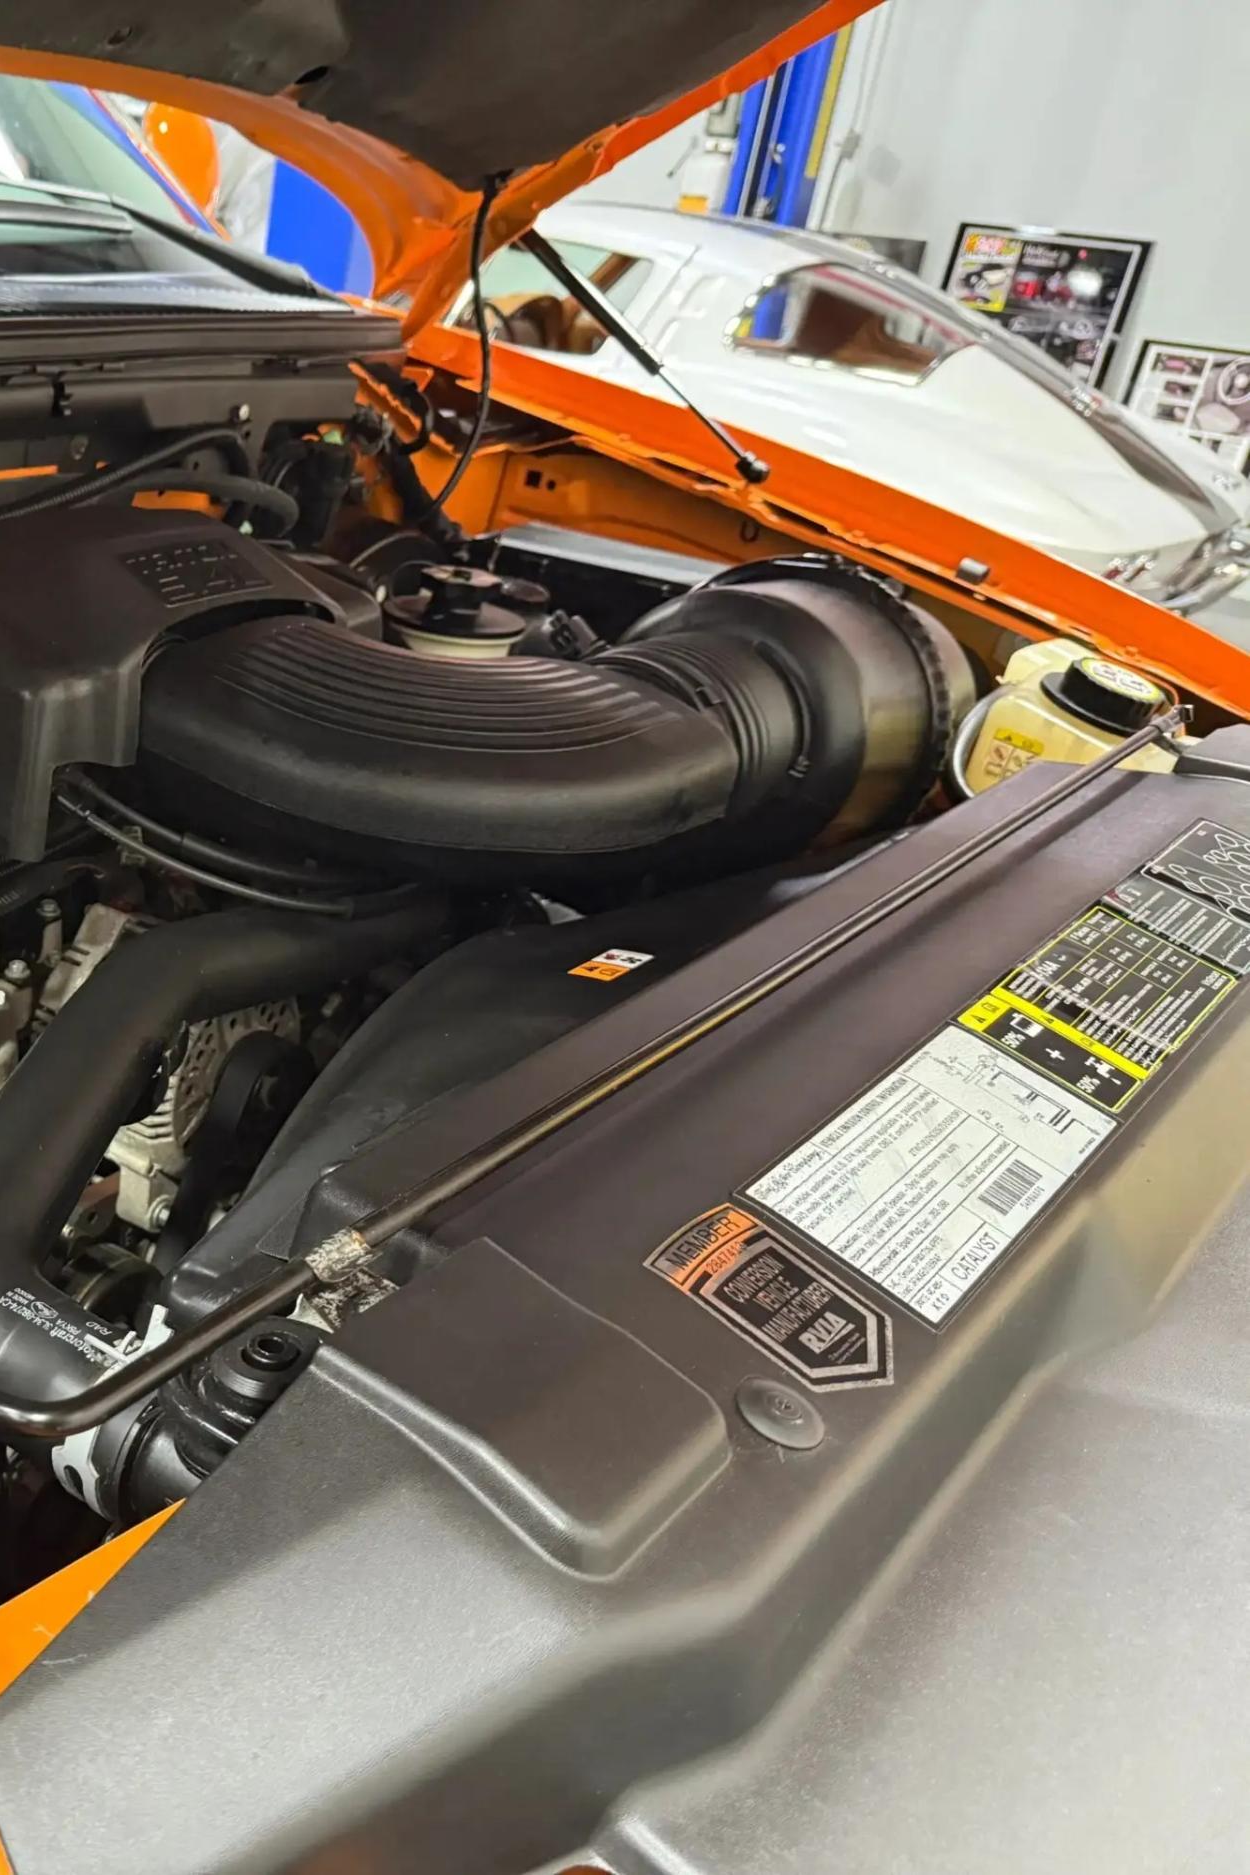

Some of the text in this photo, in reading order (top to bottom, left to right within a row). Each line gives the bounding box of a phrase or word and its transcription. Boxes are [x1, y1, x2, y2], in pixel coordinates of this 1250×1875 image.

[665, 1214, 741, 1271] MEMBER
[948, 1230, 1003, 1283] CATALYST
[723, 1252, 786, 1304] CONVERSION
[752, 1275, 800, 1312] VEHICLE
[86, 1320, 112, 1336] RAD
[761, 1281, 835, 1344] MANUFACTURER
[798, 1311, 848, 1354] RVIA
[50, 1324, 98, 1362] Motorcraft
